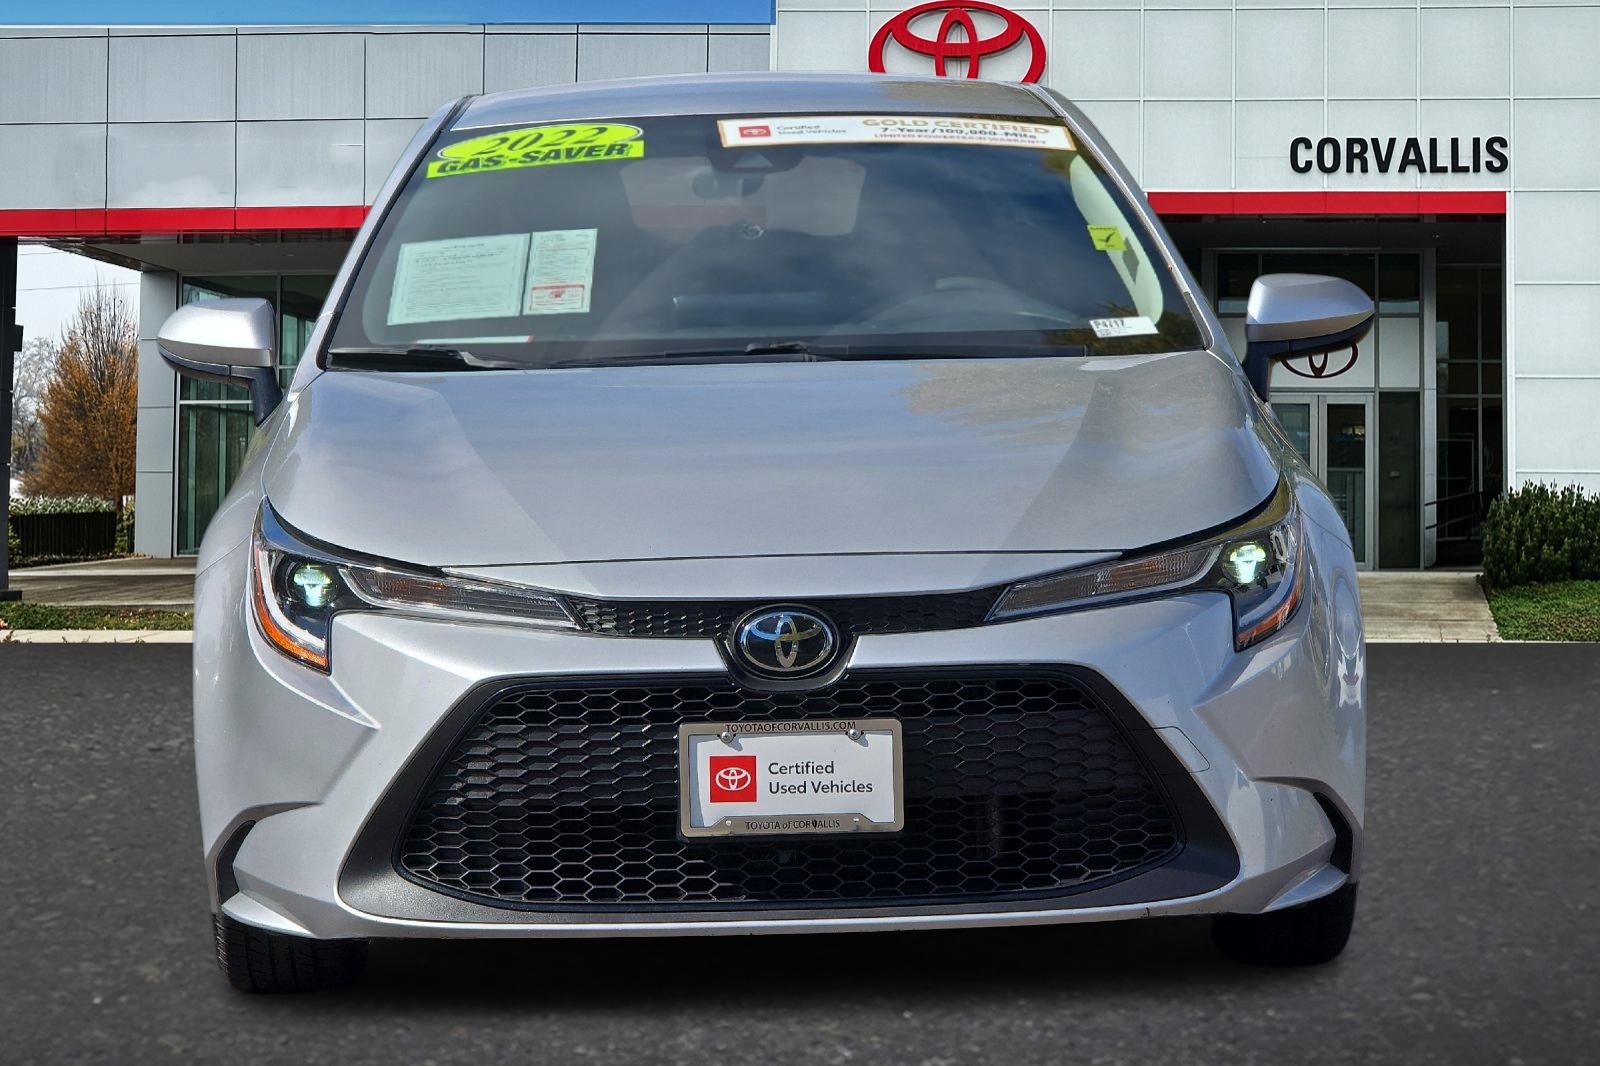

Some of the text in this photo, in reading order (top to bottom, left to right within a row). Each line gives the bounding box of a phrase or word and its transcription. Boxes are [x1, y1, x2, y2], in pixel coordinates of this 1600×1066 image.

[862, 118, 1050, 134] GOLD CERTIFIED
[471, 125, 609, 155] 2022
[436, 142, 632, 175] GAS-SAVER
[1289, 136, 1510, 174] CORVALLIS
[725, 720, 857, 733] TOYOTAOFCORVALLIS.COM
[767, 760, 835, 776] Certified
[769, 778, 874, 795] Used Vehicles
[745, 819, 841, 831] TOYOTA of CORVALLIS
